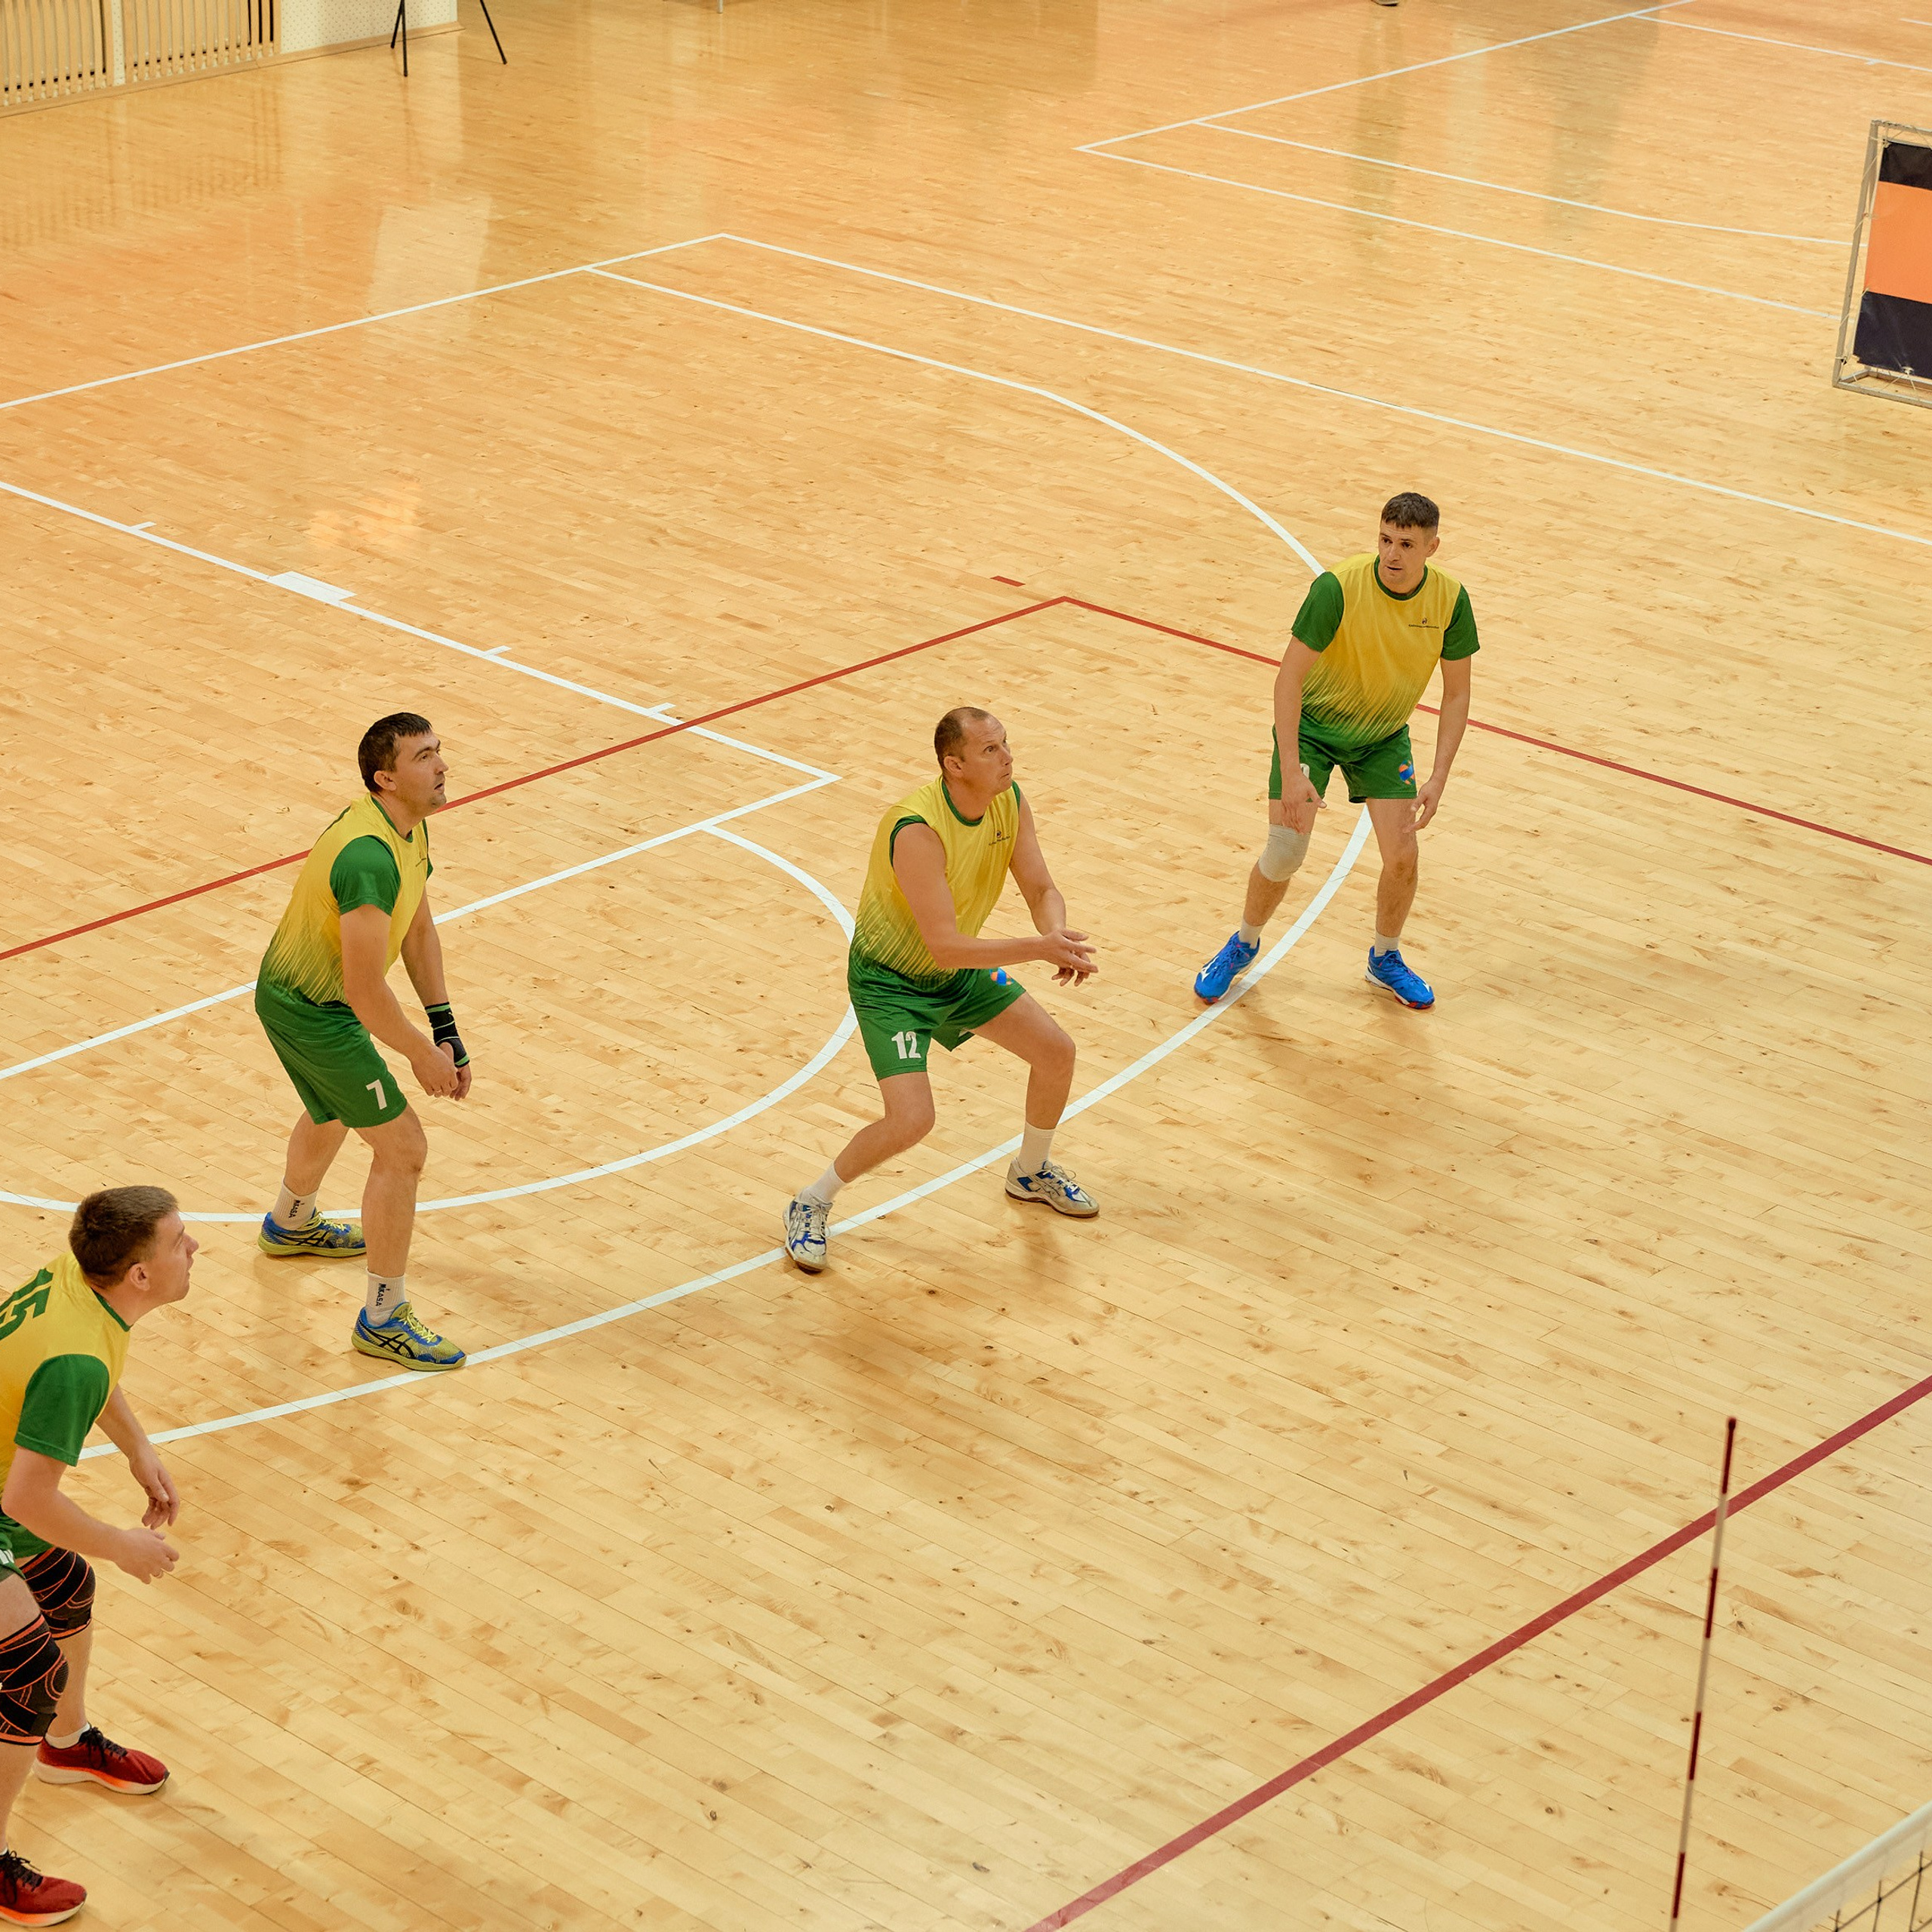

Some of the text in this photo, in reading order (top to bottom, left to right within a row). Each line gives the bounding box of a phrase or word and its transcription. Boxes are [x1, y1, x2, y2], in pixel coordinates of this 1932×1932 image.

[891, 1031, 921, 1060] 12
[365, 1078, 387, 1110] 7
[0, 1268, 54, 1341] 15
